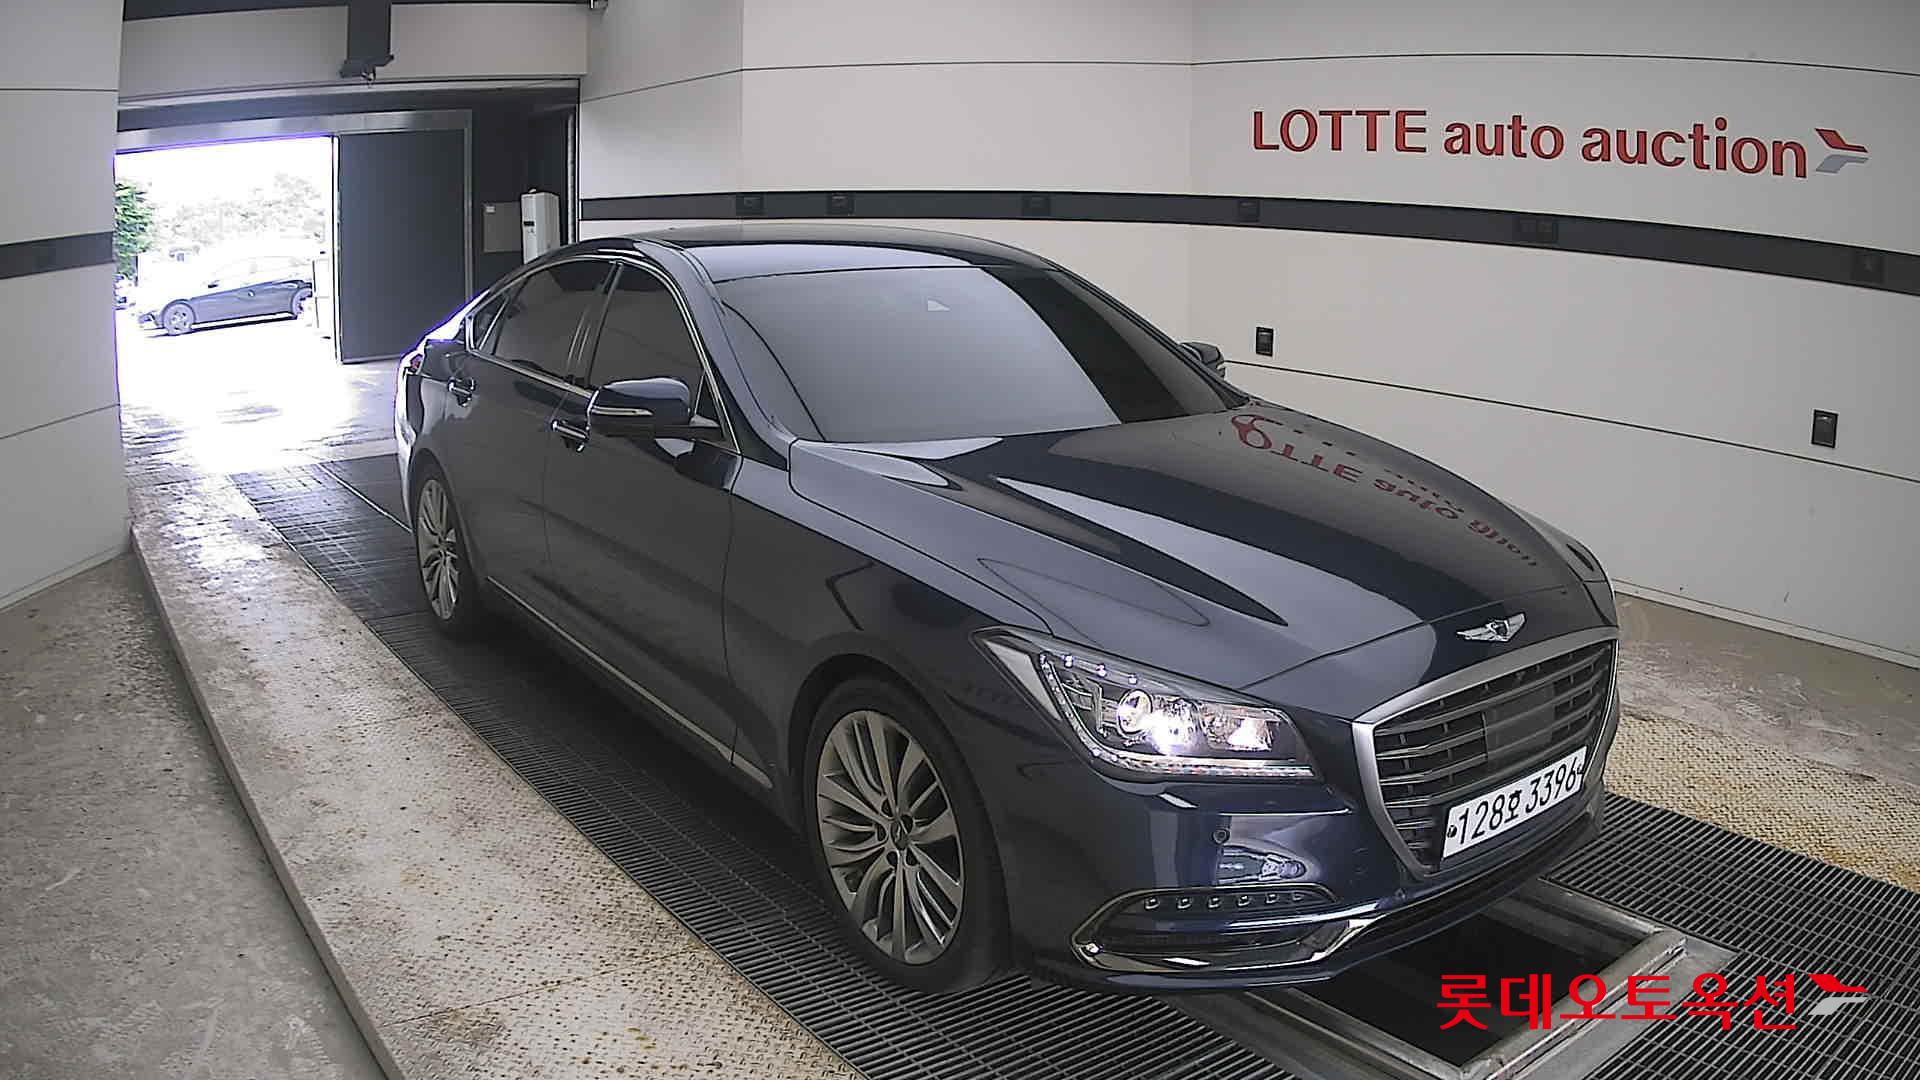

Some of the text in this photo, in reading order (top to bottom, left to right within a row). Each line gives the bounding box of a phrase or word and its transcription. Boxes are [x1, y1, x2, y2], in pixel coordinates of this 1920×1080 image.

[1252, 109, 1808, 179] LOTTE auto auction
[1458, 756, 1579, 845] 128호 3396
